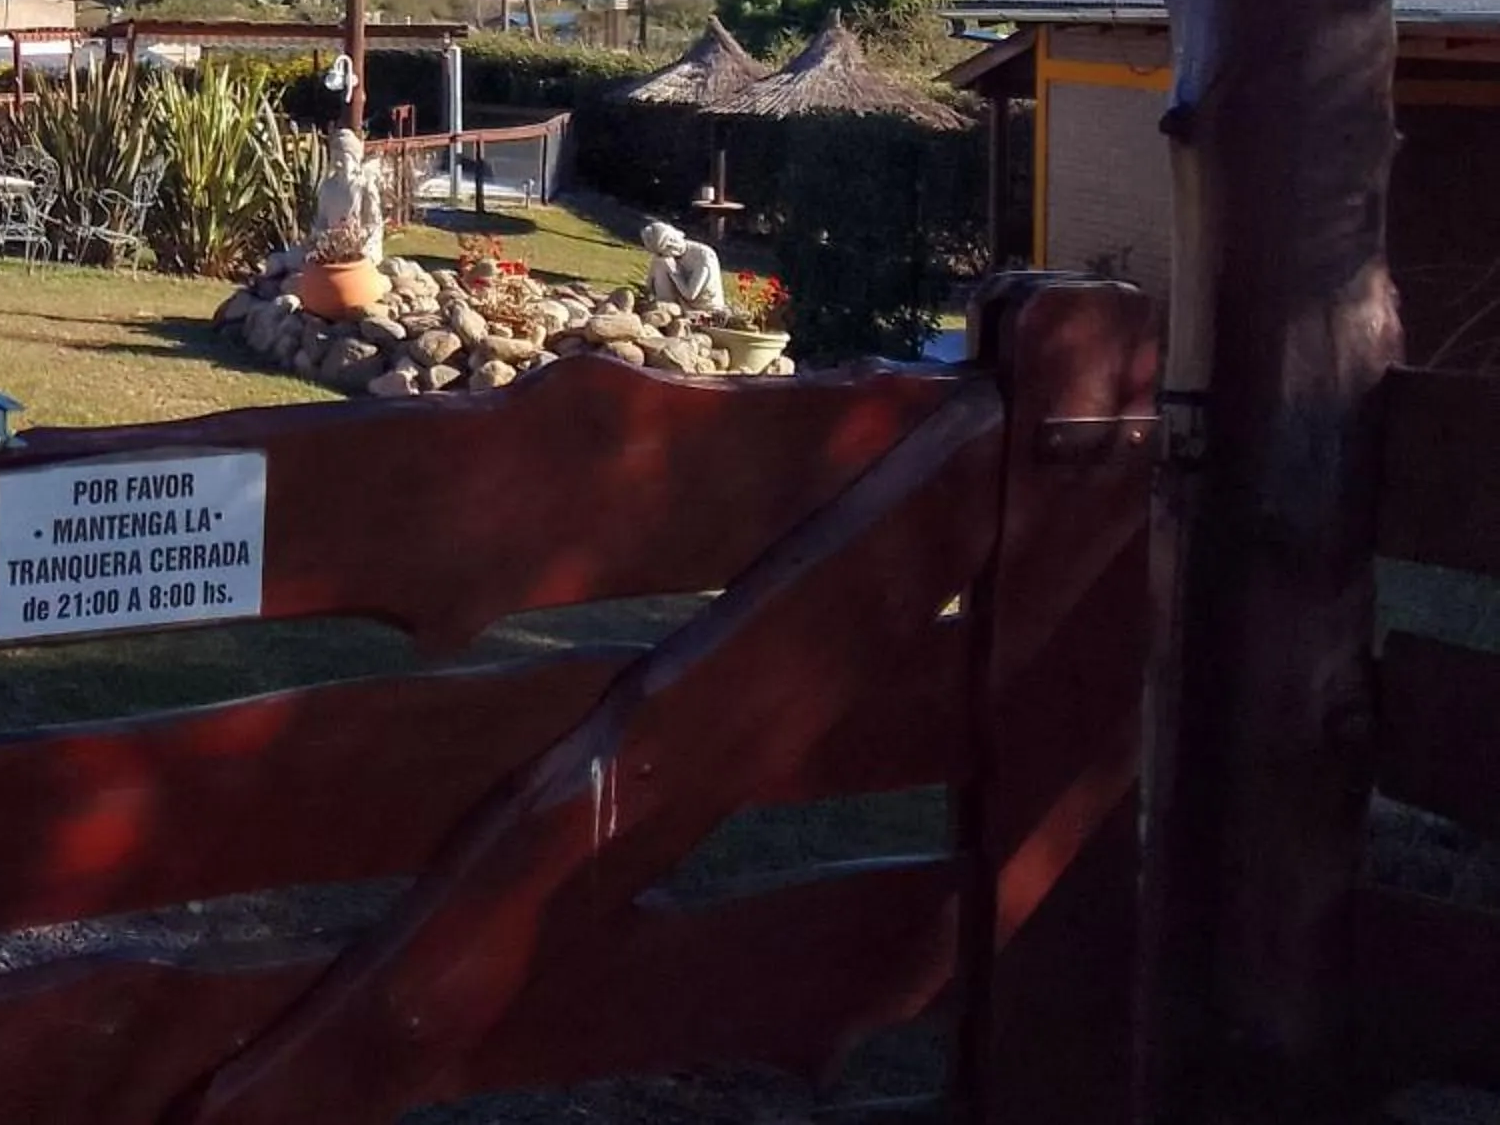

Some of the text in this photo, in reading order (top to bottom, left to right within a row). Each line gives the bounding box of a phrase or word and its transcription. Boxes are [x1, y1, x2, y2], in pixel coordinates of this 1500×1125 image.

[73, 473, 194, 505] POR FAVOR
[53, 507, 211, 544] MANTENGA LA
[7, 540, 249, 586] TRANQUERA CERRADA
[23, 580, 233, 622] de 21:00 A 8:00 hs.
